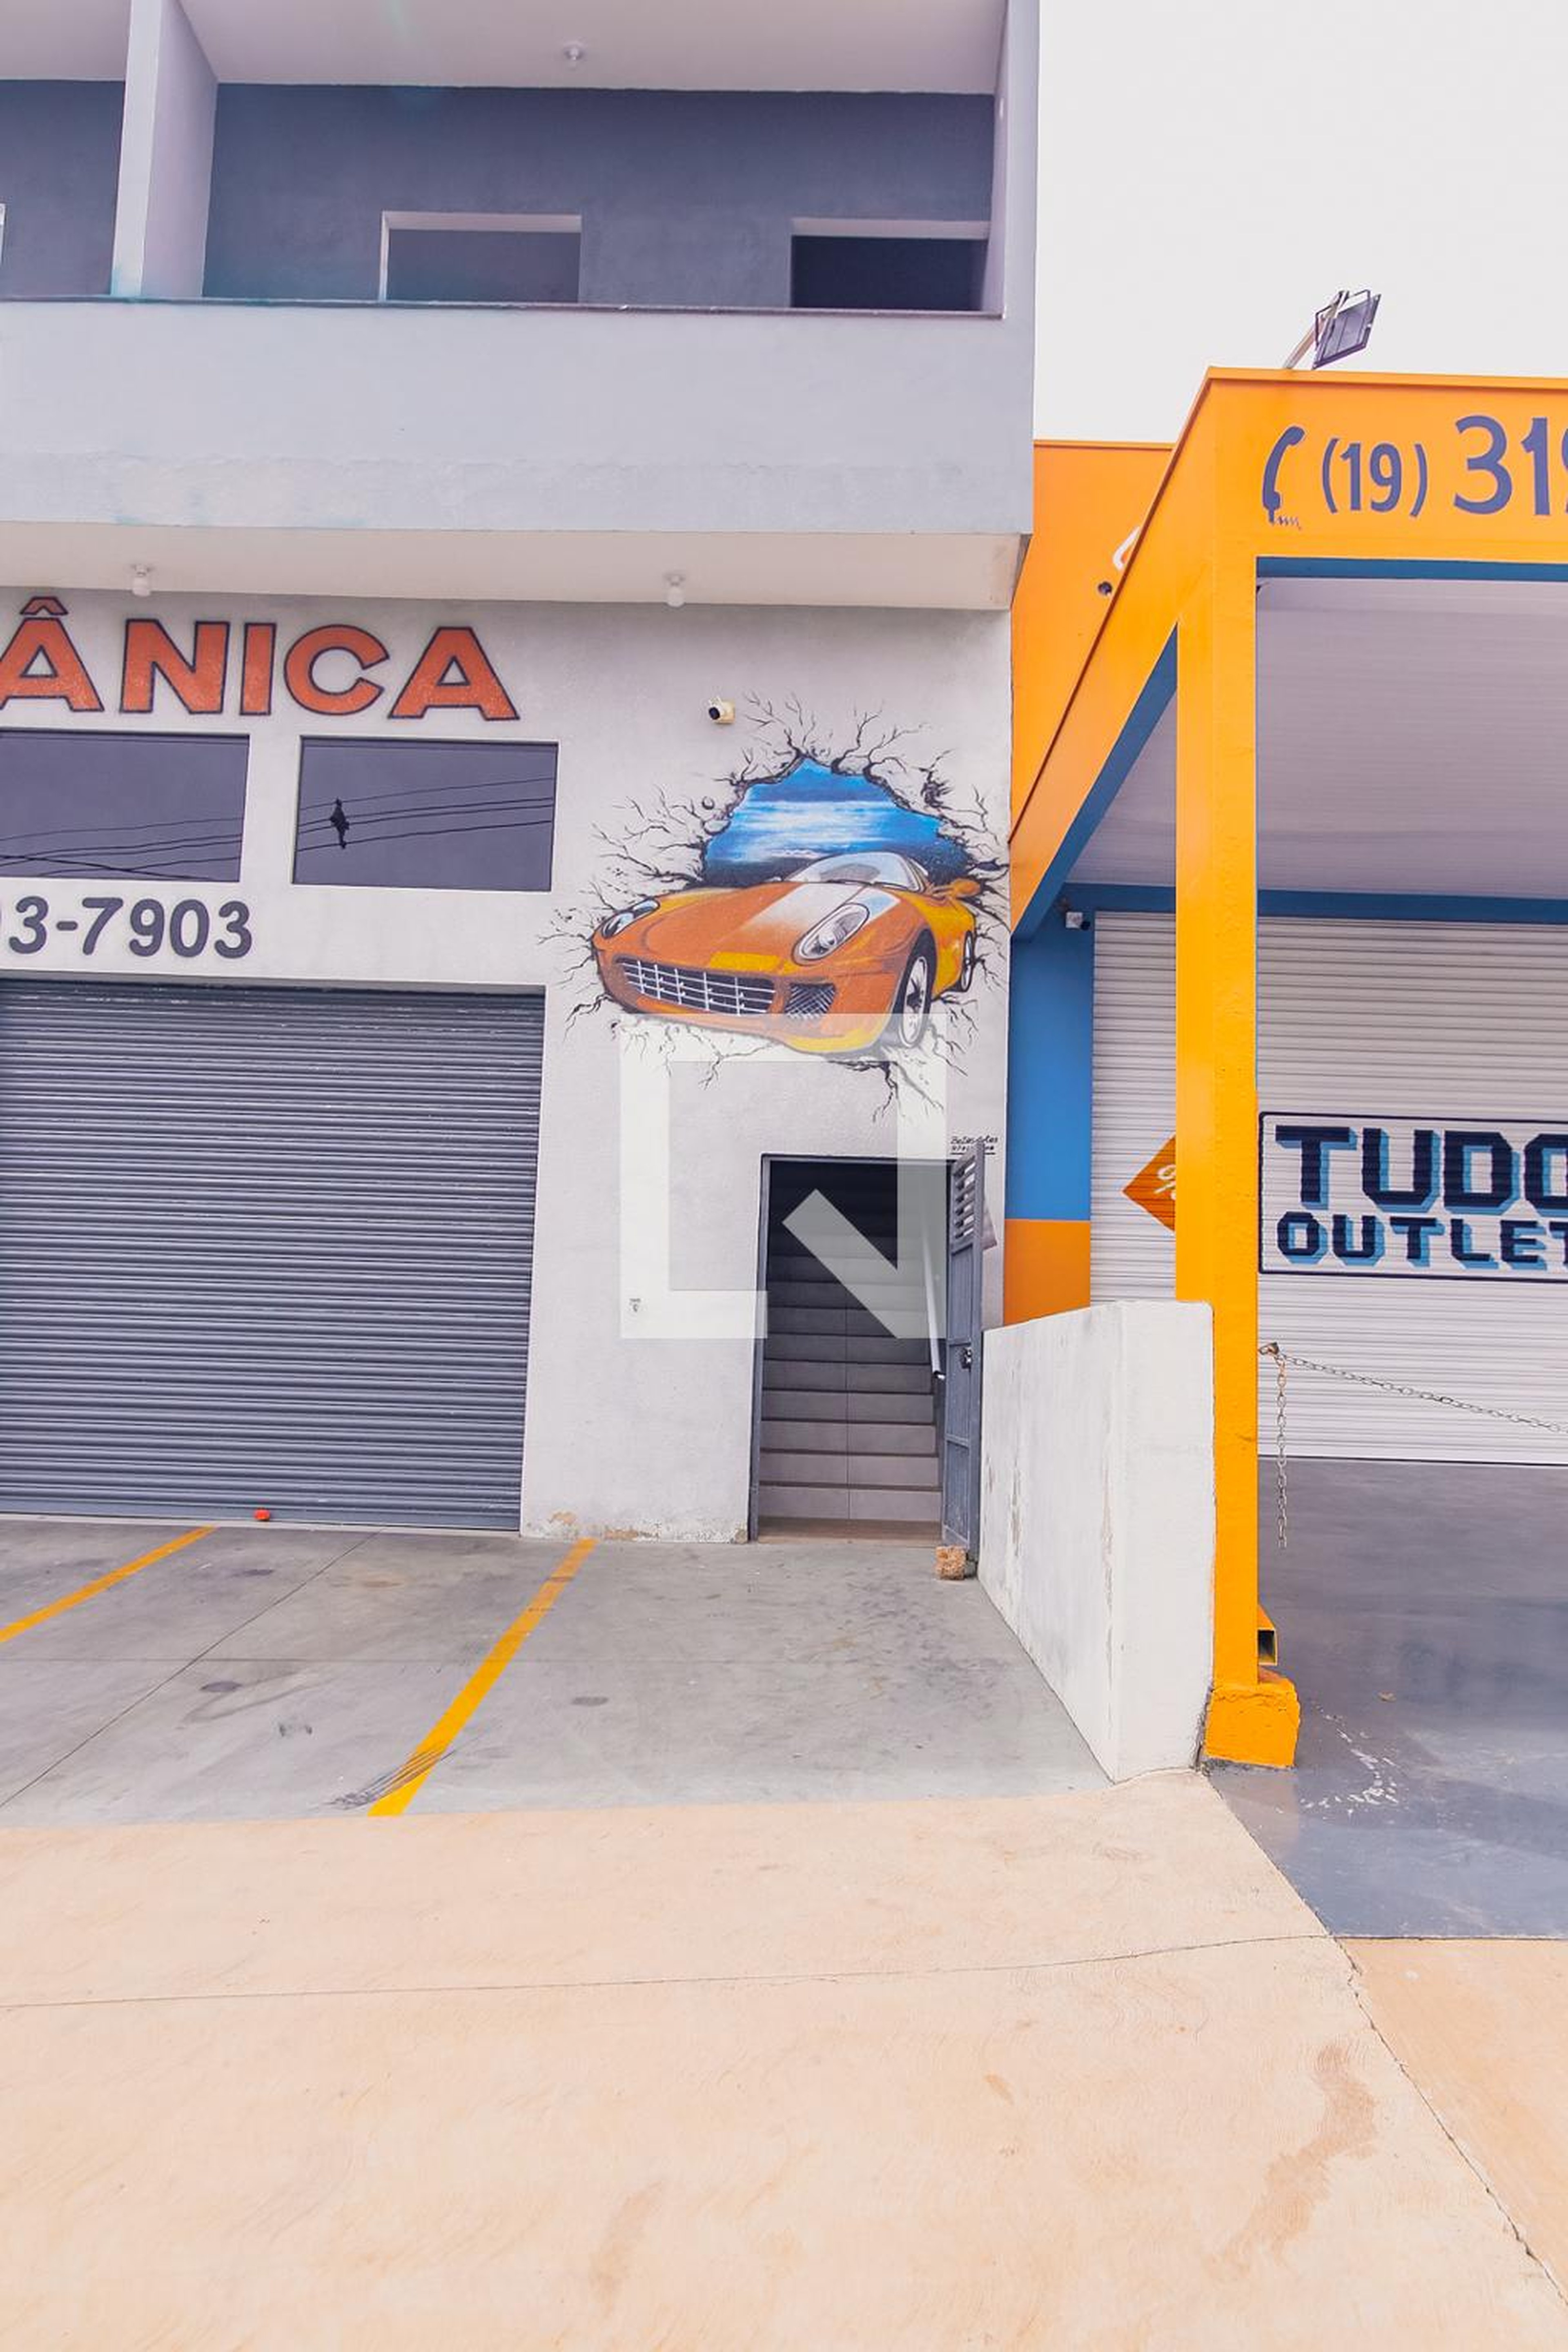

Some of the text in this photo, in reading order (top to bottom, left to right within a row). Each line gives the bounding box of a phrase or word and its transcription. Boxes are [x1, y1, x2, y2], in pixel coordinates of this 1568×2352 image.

[1321, 415, 1568, 518] (19) 31
[0, 597, 520, 720] ÂNICA
[0, 895, 253, 958] 3-7903
